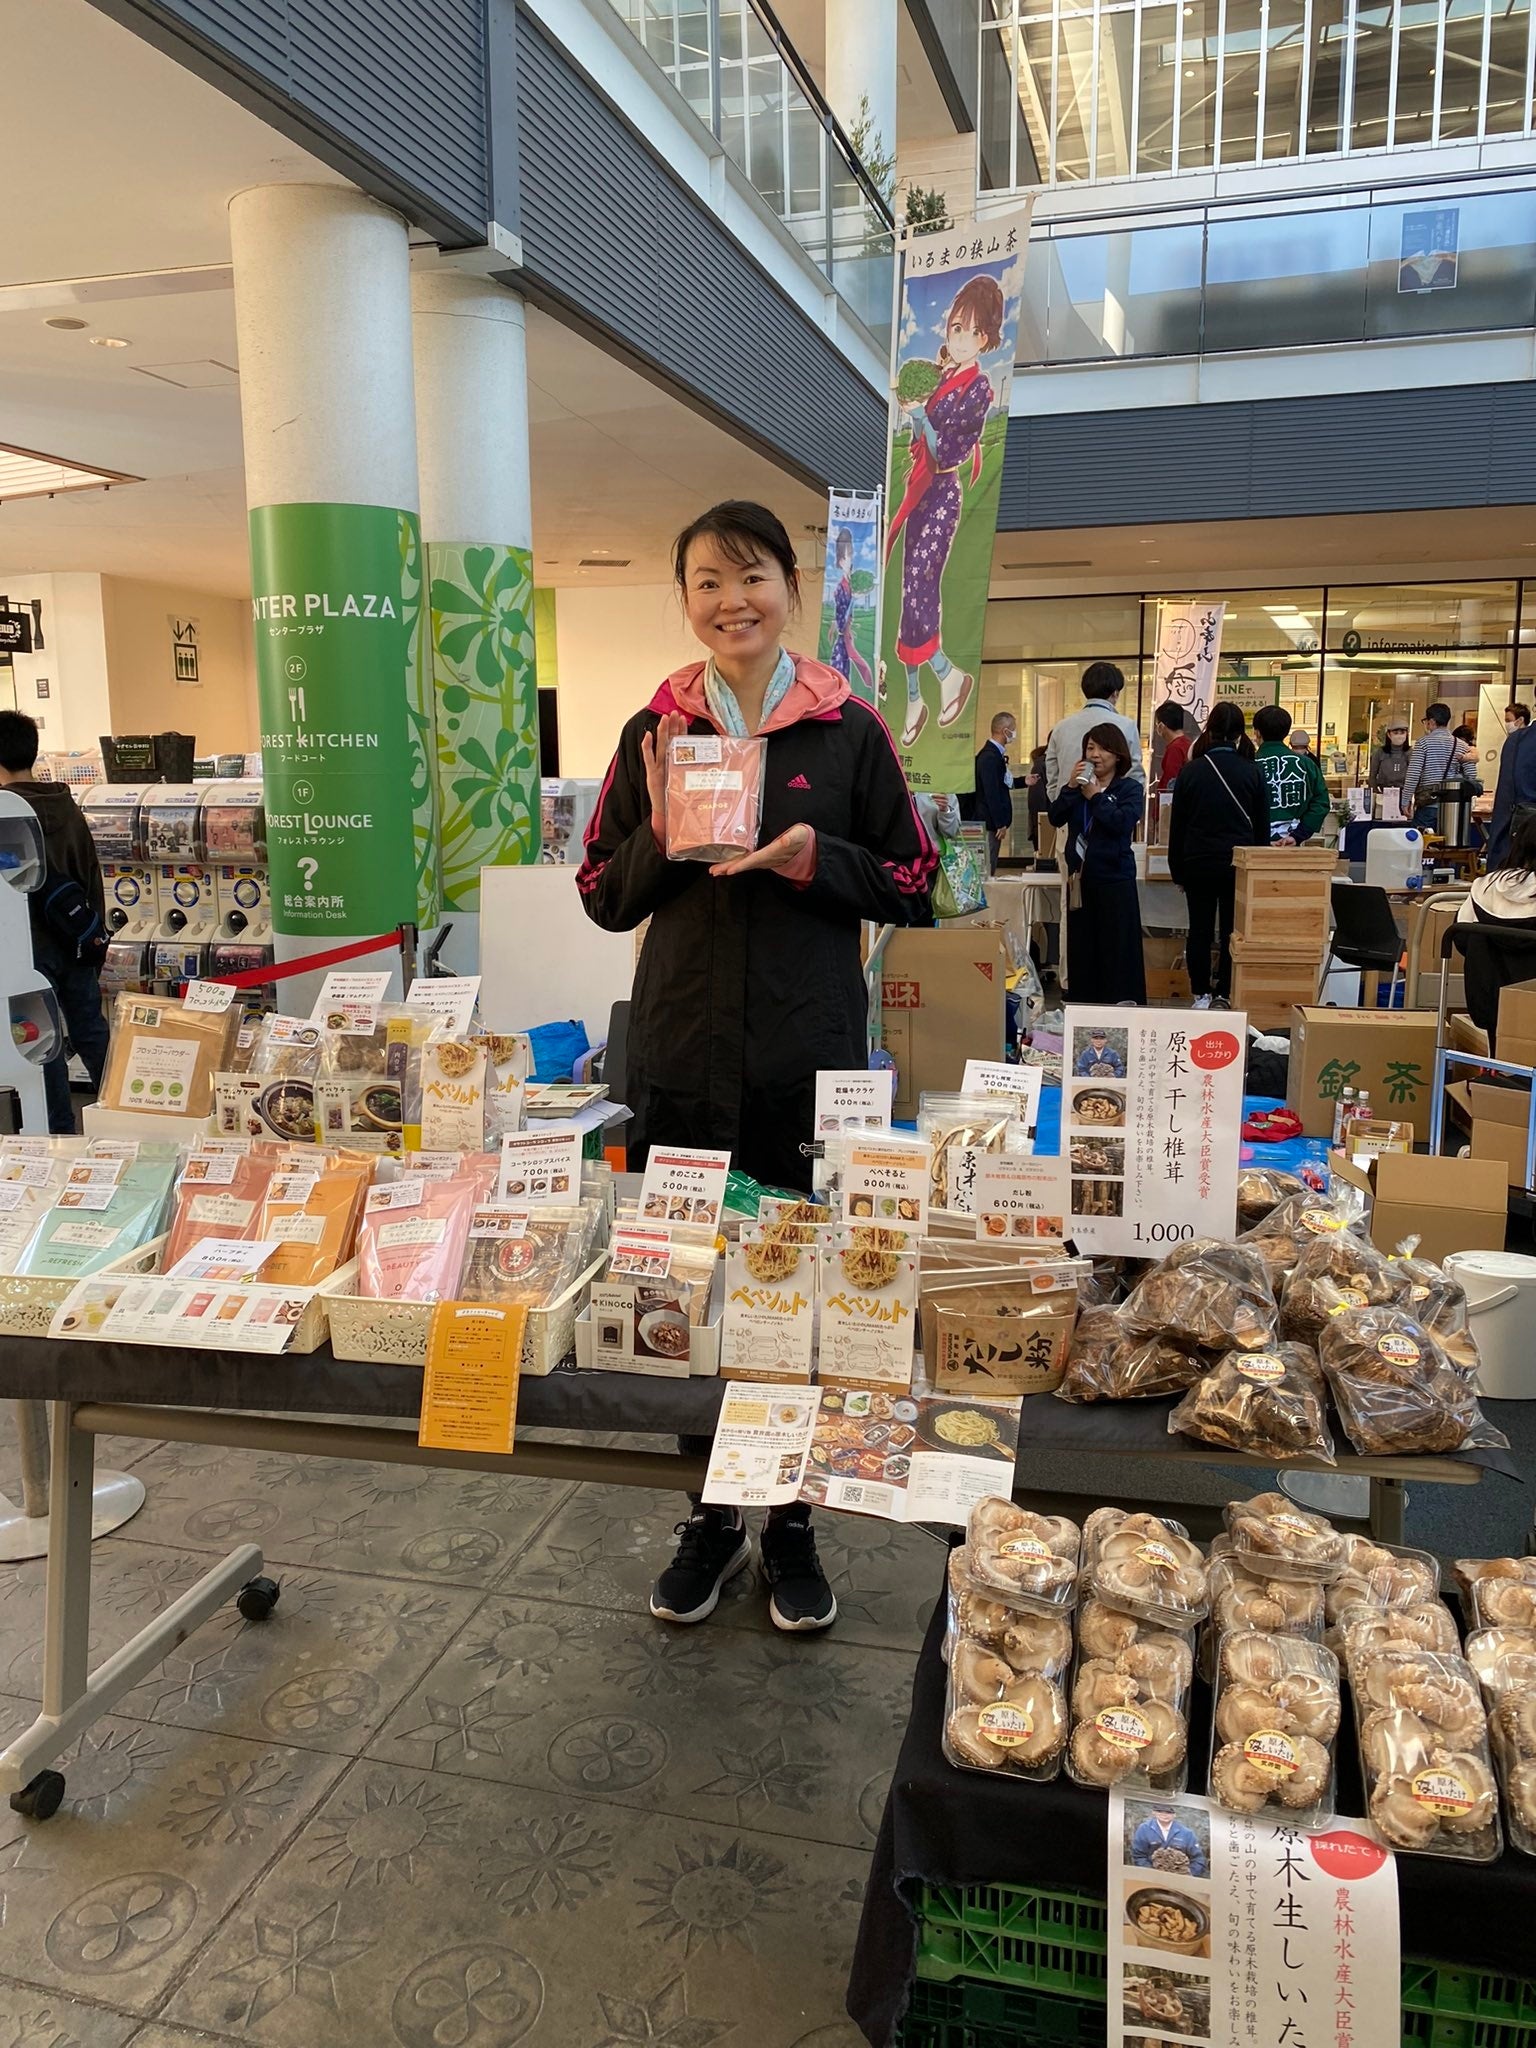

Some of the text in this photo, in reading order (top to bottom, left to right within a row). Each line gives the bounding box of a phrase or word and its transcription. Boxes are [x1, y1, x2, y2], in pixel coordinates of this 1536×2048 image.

[911, 227, 1019, 269] いるまの狭山茶
[304, 593, 397, 619] PLAZA
[269, 624, 325, 637] センタープラザ
[1366, 637, 1440, 656] information
[289, 663, 302, 674] 2F
[296, 725, 379, 748] KITCHEN
[281, 754, 326, 762] フードコート
[787, 781, 812, 790] adidas
[297, 788, 309, 797] 1F
[303, 812, 373, 835] LOUNGE
[277, 836, 345, 845] フォレストラウンジ
[283, 894, 345, 909] 総合案内所
[283, 910, 347, 919] Information Desk
[1205, 1040, 1224, 1049] 出汁
[1196, 1050, 1232, 1060] しっかり
[1316, 1058, 1430, 1105] 銘茶
[425, 1080, 480, 1106] ペペソルト
[1162, 1030, 1190, 1186] 原木 干し椎茸
[1197, 1073, 1216, 1201] 農林水産大臣賞受賞
[511, 1156, 571, 1167] コーラシロップスパイス
[523, 1167, 567, 1176] 700円（税込）
[670, 1169, 705, 1180] きのここあ
[662, 1181, 706, 1193] 500円（税込）
[863, 1179, 909, 1191] 900円（税込）
[1012, 1189, 1032, 1197] だし粉
[993, 1199, 1045, 1210] 600円（税込）
[1133, 1222, 1195, 1244] 1,000
[600, 1299, 633, 1309] KINOCO
[729, 1285, 808, 1316] ペペソルト
[826, 1291, 909, 1324] ペペソルト
[963, 1330, 1053, 1379] だし粉
[1000, 1710, 1018, 1720] 原木
[1120, 1714, 1138, 1726] 原木
[995, 1719, 1026, 1731] しいたけ
[1114, 1720, 1146, 1737] しいたけ
[1268, 1737, 1287, 1750] 原木
[1261, 1744, 1295, 1762] しいたけ
[1436, 1776, 1457, 1788] 原木
[1431, 1785, 1467, 1800] しいたけ
[1314, 1840, 1382, 1859] 採れたて！
